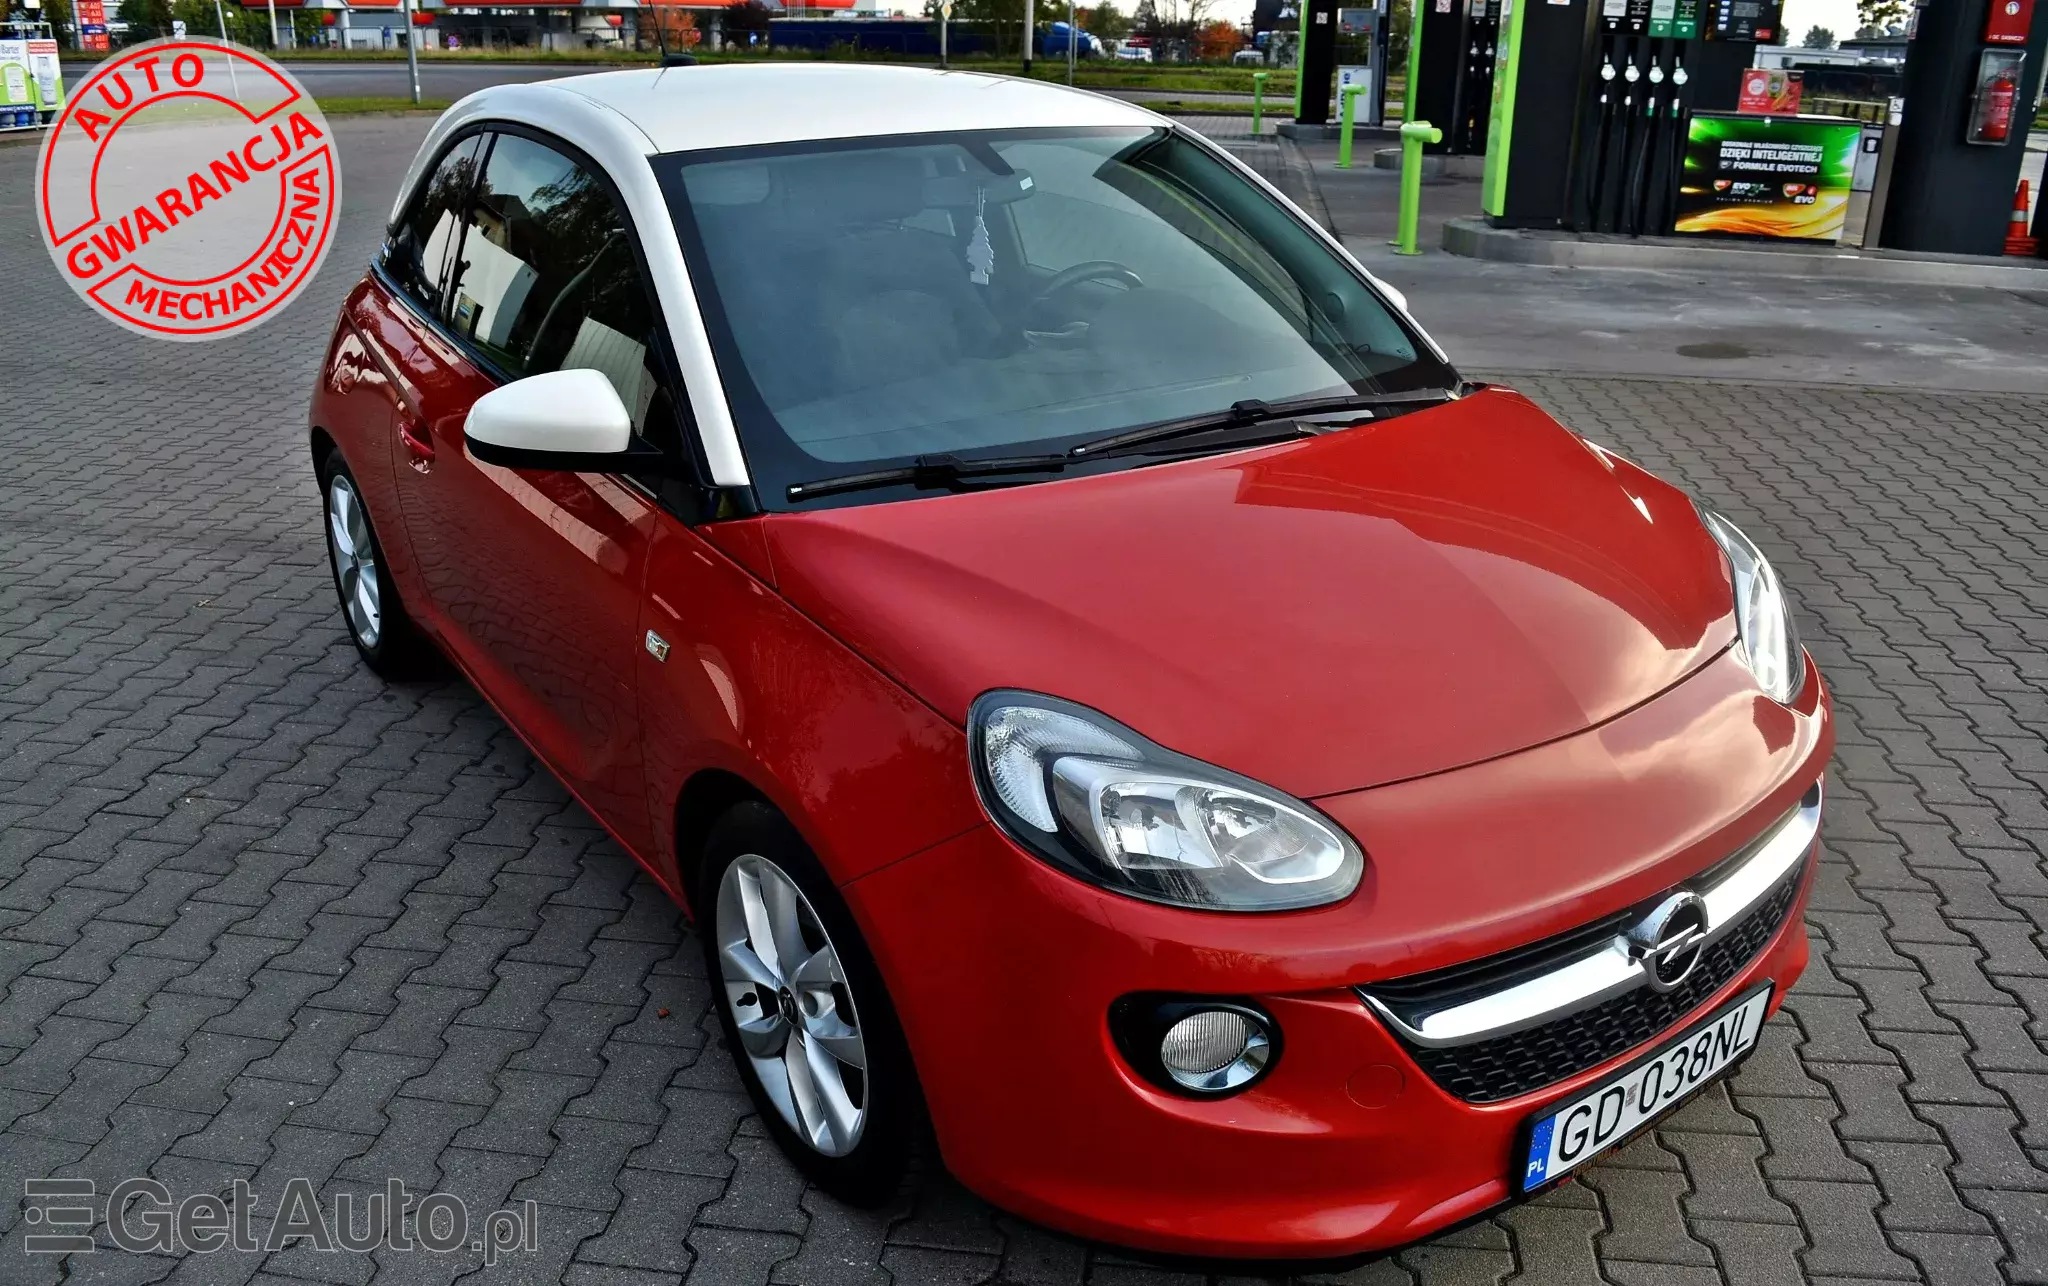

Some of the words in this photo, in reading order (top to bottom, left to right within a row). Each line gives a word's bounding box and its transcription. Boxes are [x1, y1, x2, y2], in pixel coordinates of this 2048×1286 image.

[1720, 147, 1751, 160] DZIĘKI
[1752, 149, 1823, 162] INTELIGENTNEJ
[1733, 161, 1775, 171] FORMULE
[1776, 163, 1818, 173] EVOTECH
[1794, 195, 1816, 204] EVO
[1558, 1085, 1626, 1162] GD
[1639, 1005, 1750, 1115] 038NL
[1527, 1158, 1545, 1177] PL
